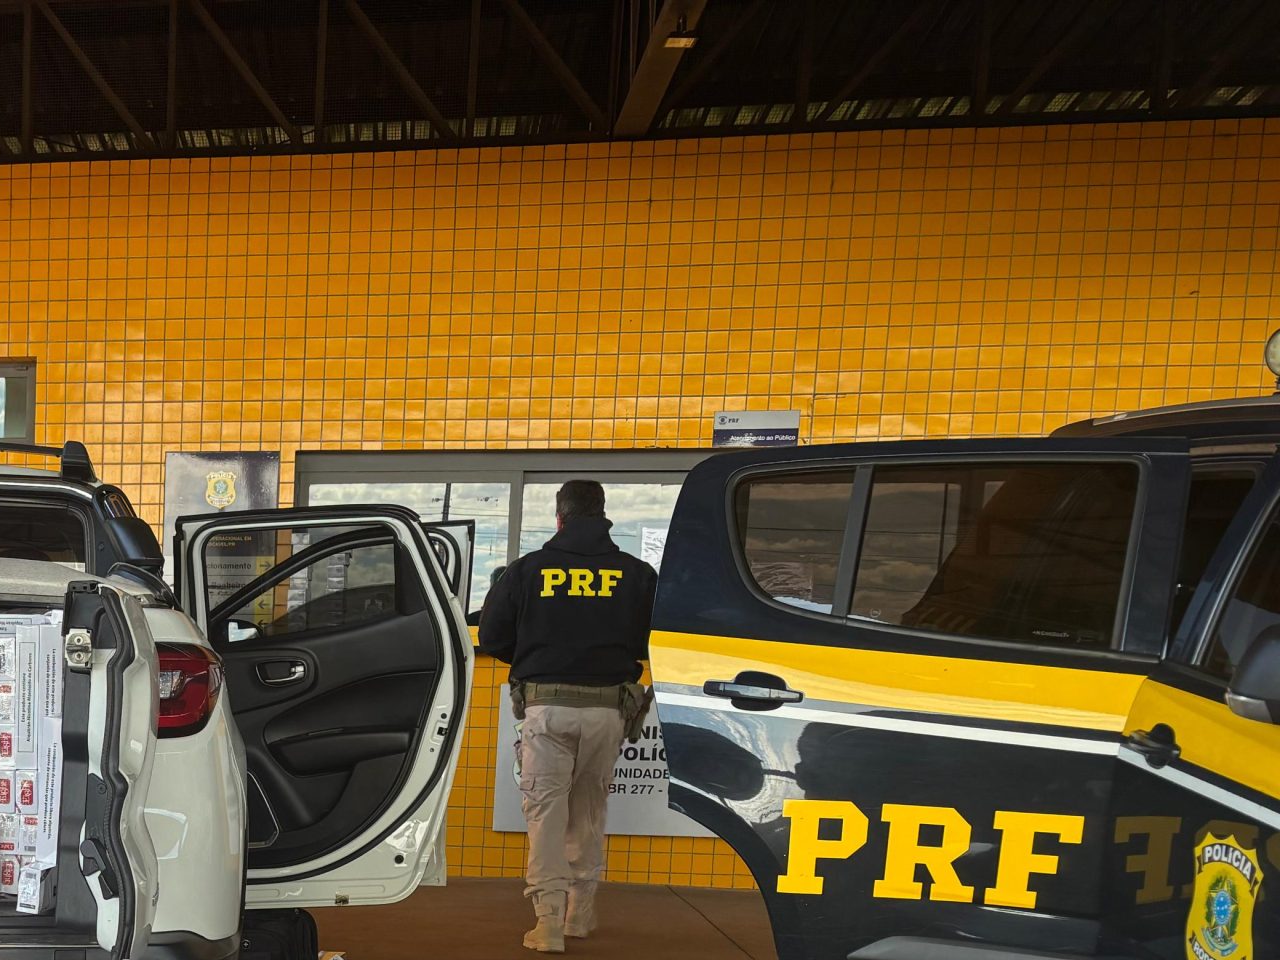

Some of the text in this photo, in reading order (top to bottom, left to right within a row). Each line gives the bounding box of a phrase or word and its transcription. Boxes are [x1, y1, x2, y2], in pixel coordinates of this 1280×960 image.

[540, 568, 623, 597] PRF
[608, 784, 626, 793] BR
[631, 784, 654, 794] 277
[776, 799, 1085, 909] PRF
